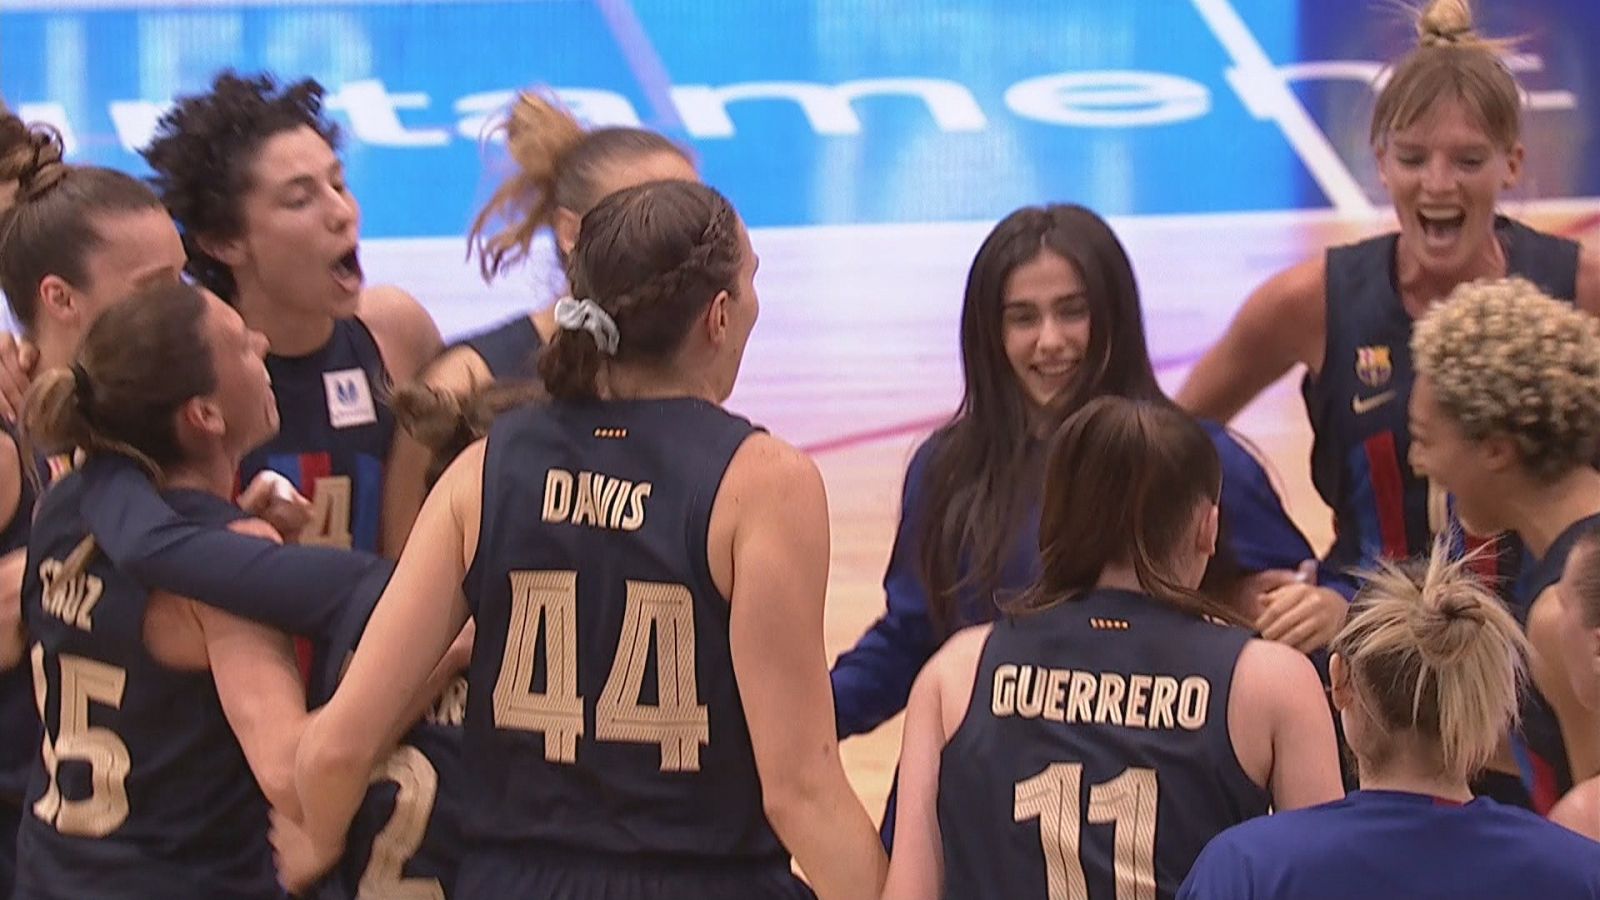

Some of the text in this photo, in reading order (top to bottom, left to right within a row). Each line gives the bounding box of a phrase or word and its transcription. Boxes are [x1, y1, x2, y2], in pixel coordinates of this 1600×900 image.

[541, 468, 652, 532] DAVIS
[492, 568, 710, 773] 44
[991, 664, 1211, 730] GUERRERO
[354, 745, 446, 900] 2
[1013, 761, 1159, 900] 11
